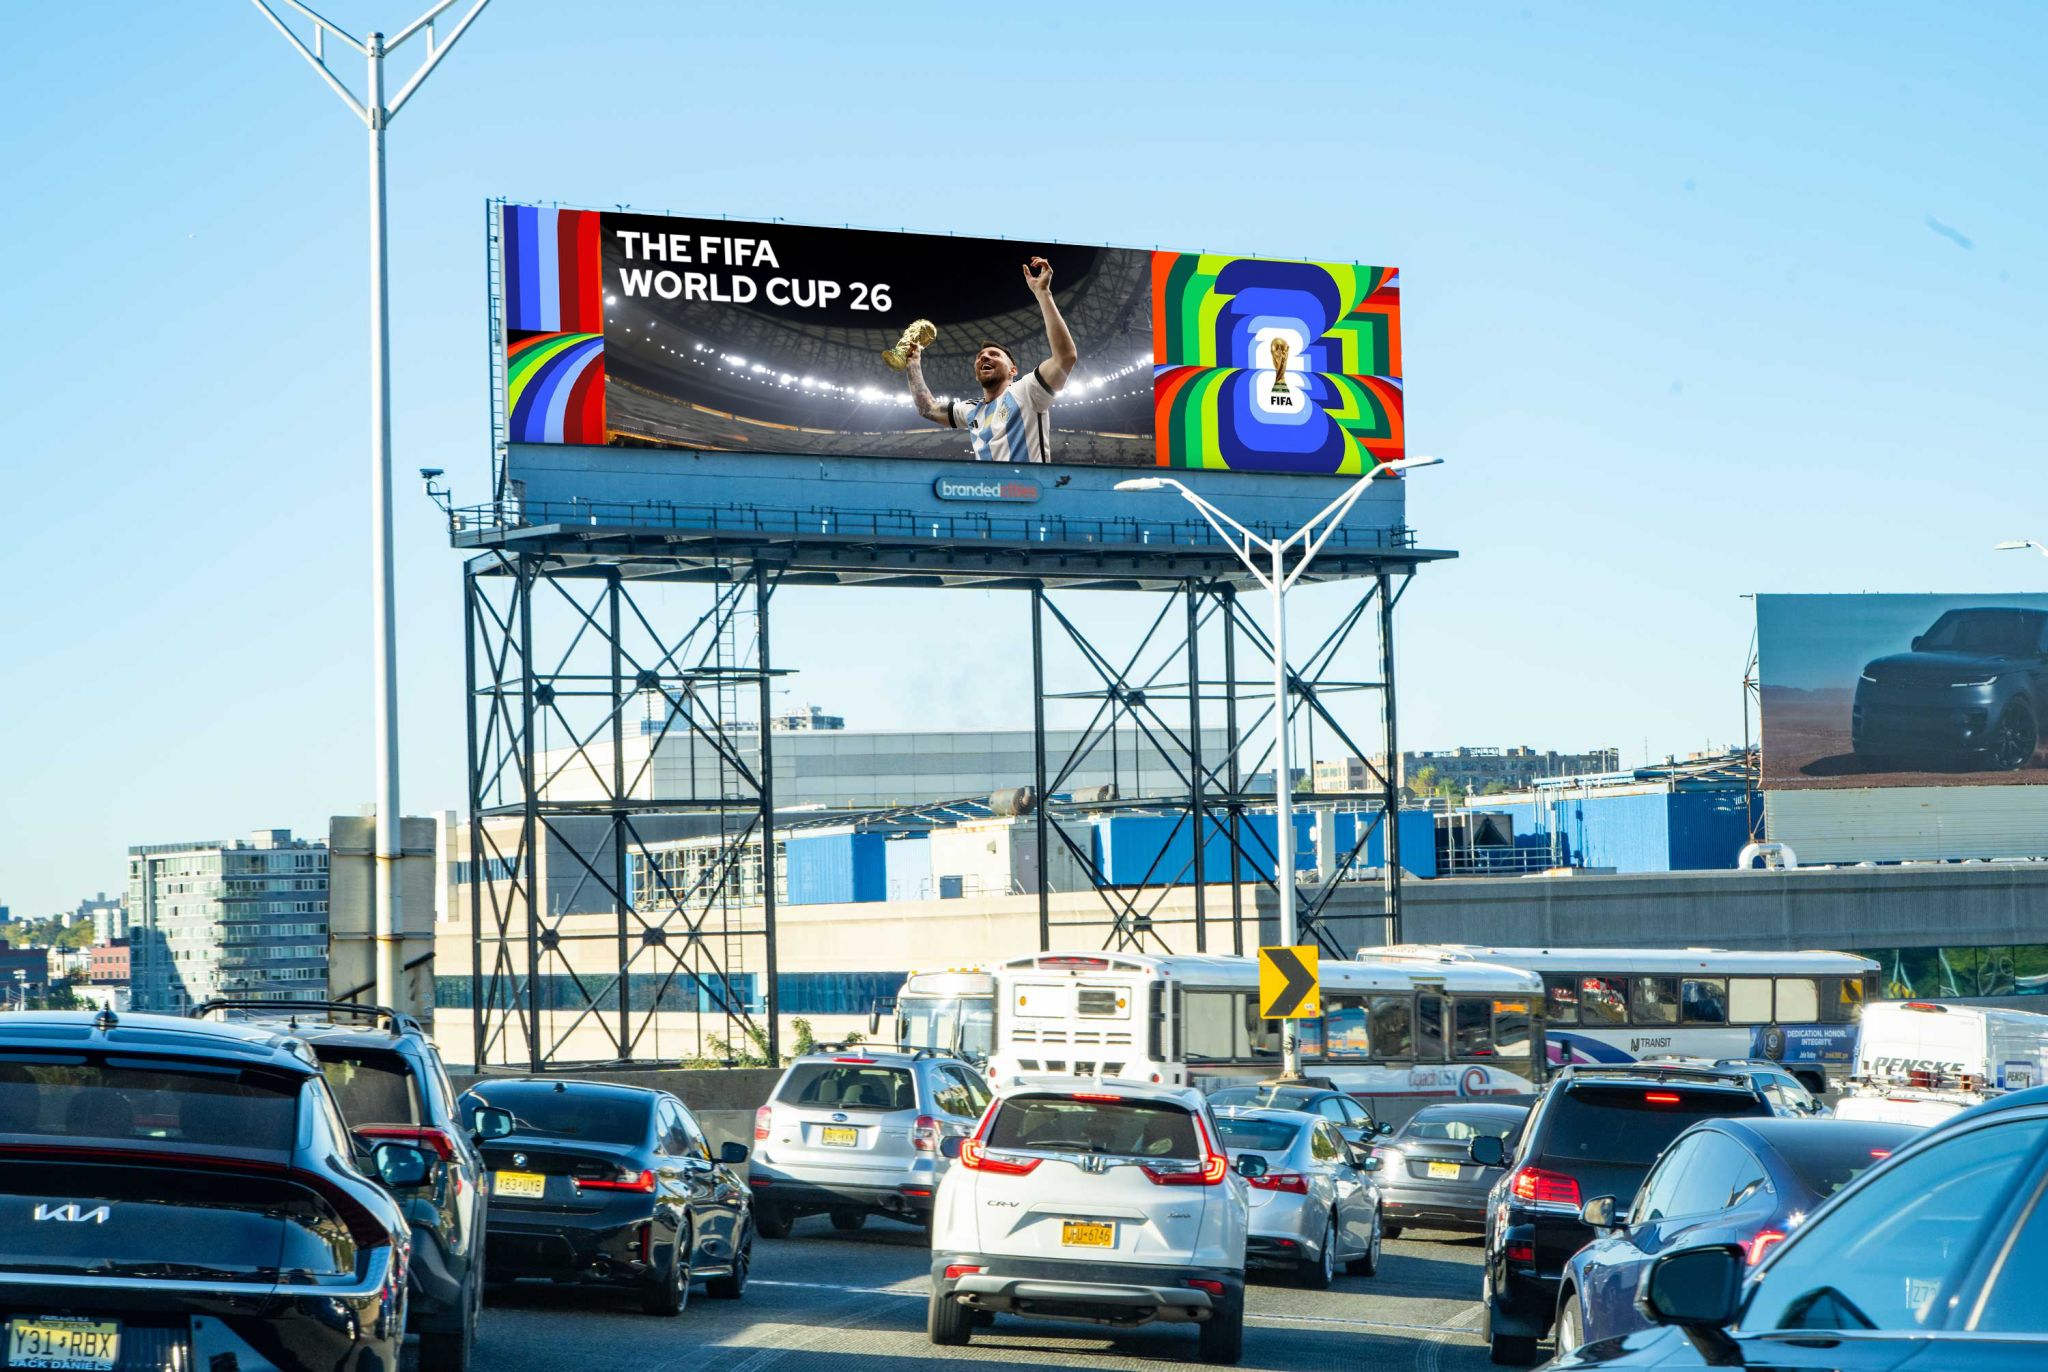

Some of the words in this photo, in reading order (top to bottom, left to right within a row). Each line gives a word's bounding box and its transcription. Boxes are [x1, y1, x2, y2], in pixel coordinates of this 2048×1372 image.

[616, 230, 692, 263] THE
[699, 235, 780, 268] FIFA
[618, 268, 757, 304] WORLD
[765, 276, 841, 308] CUP
[848, 281, 893, 312] 26
[1270, 396, 1293, 406] FIFA
[1640, 1037, 1672, 1048] TRANSIT
[1871, 1056, 1966, 1075] PENSKE
[34, 1203, 110, 1224] KIA
[987, 1200, 1020, 1208] CR-V
[16, 1329, 53, 1355] Y31
[70, 1331, 112, 1358] RBX
[8, 1360, 48, 1369] JACK
[51, 1361, 113, 1371] DANIELS
